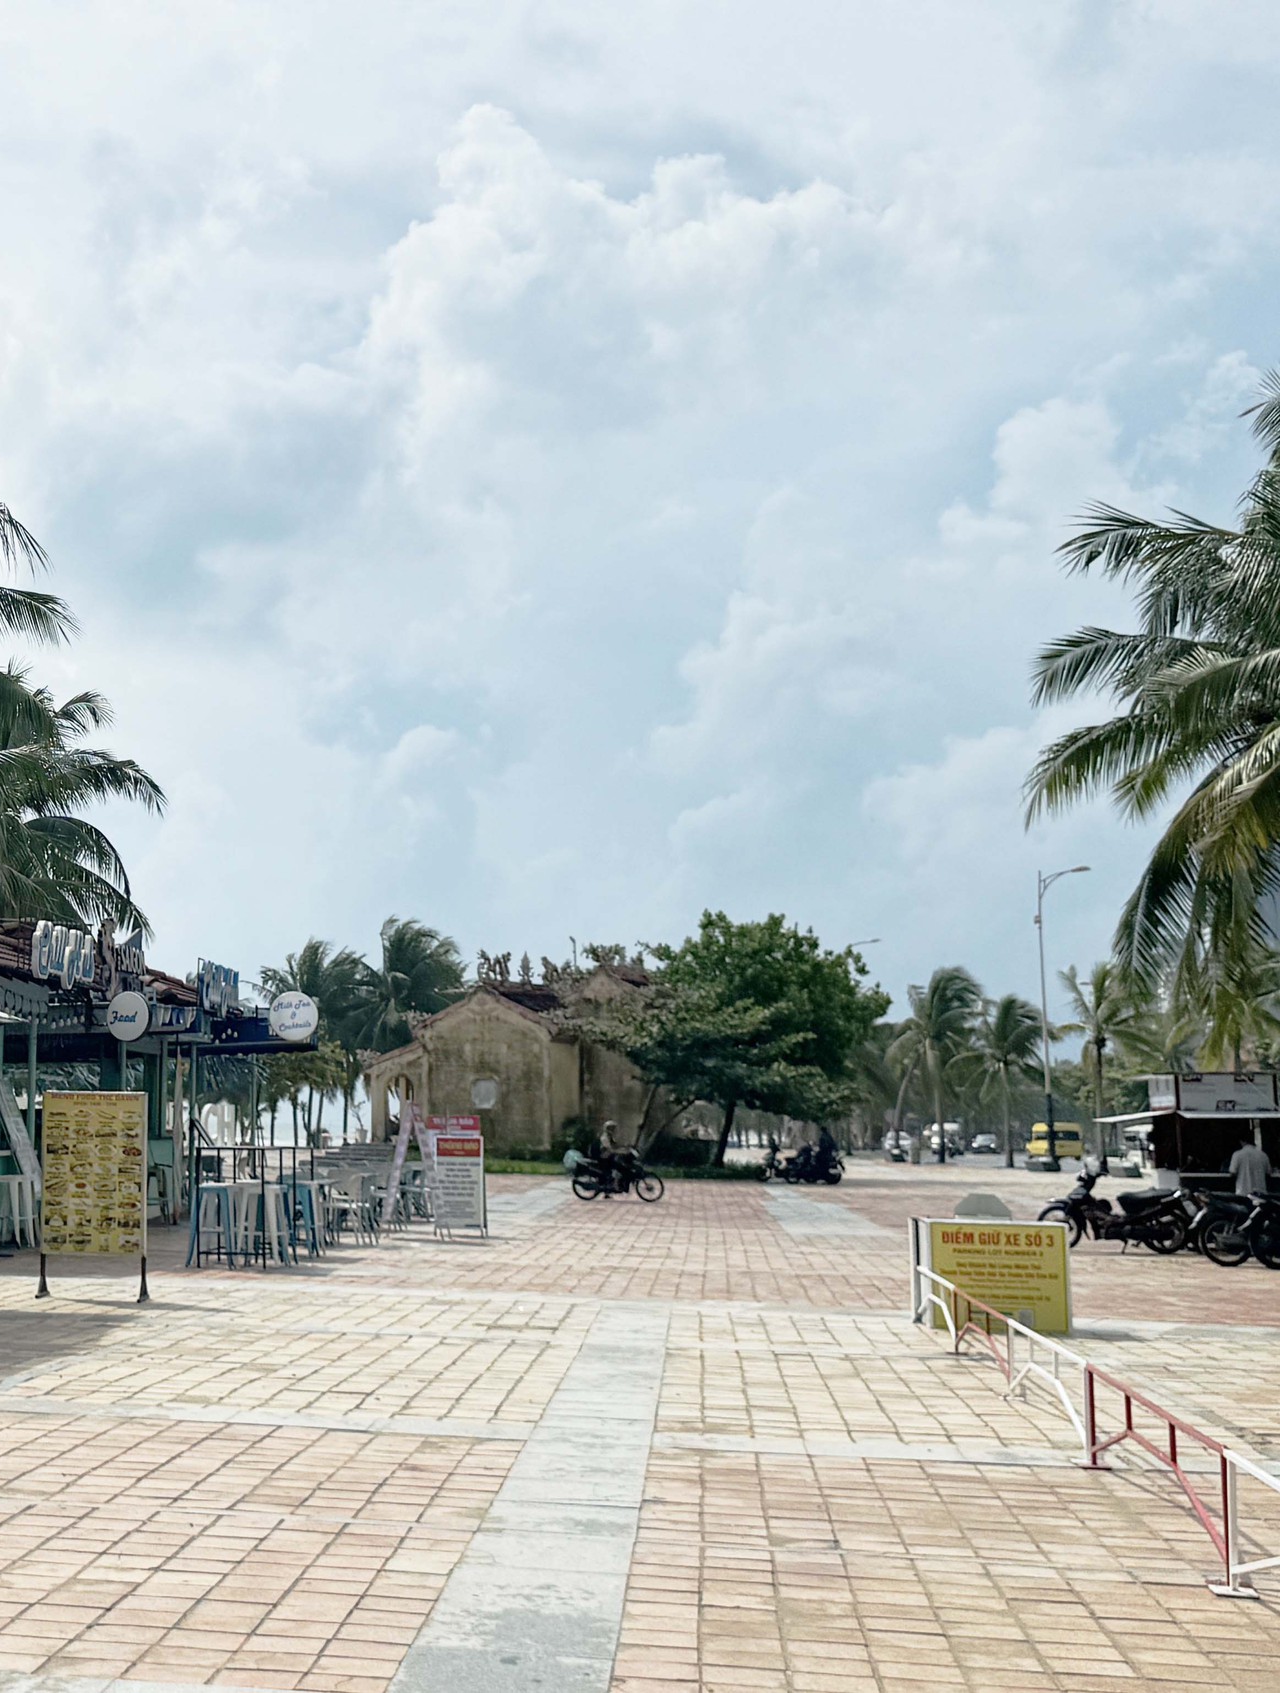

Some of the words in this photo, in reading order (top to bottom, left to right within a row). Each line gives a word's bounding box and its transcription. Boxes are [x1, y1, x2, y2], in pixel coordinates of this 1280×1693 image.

[110, 1010, 138, 1025] Food
[1004, 1233, 1021, 1246] XE
[1025, 1229, 1042, 1247] SỐ
[1046, 1234, 1054, 1247] 3
